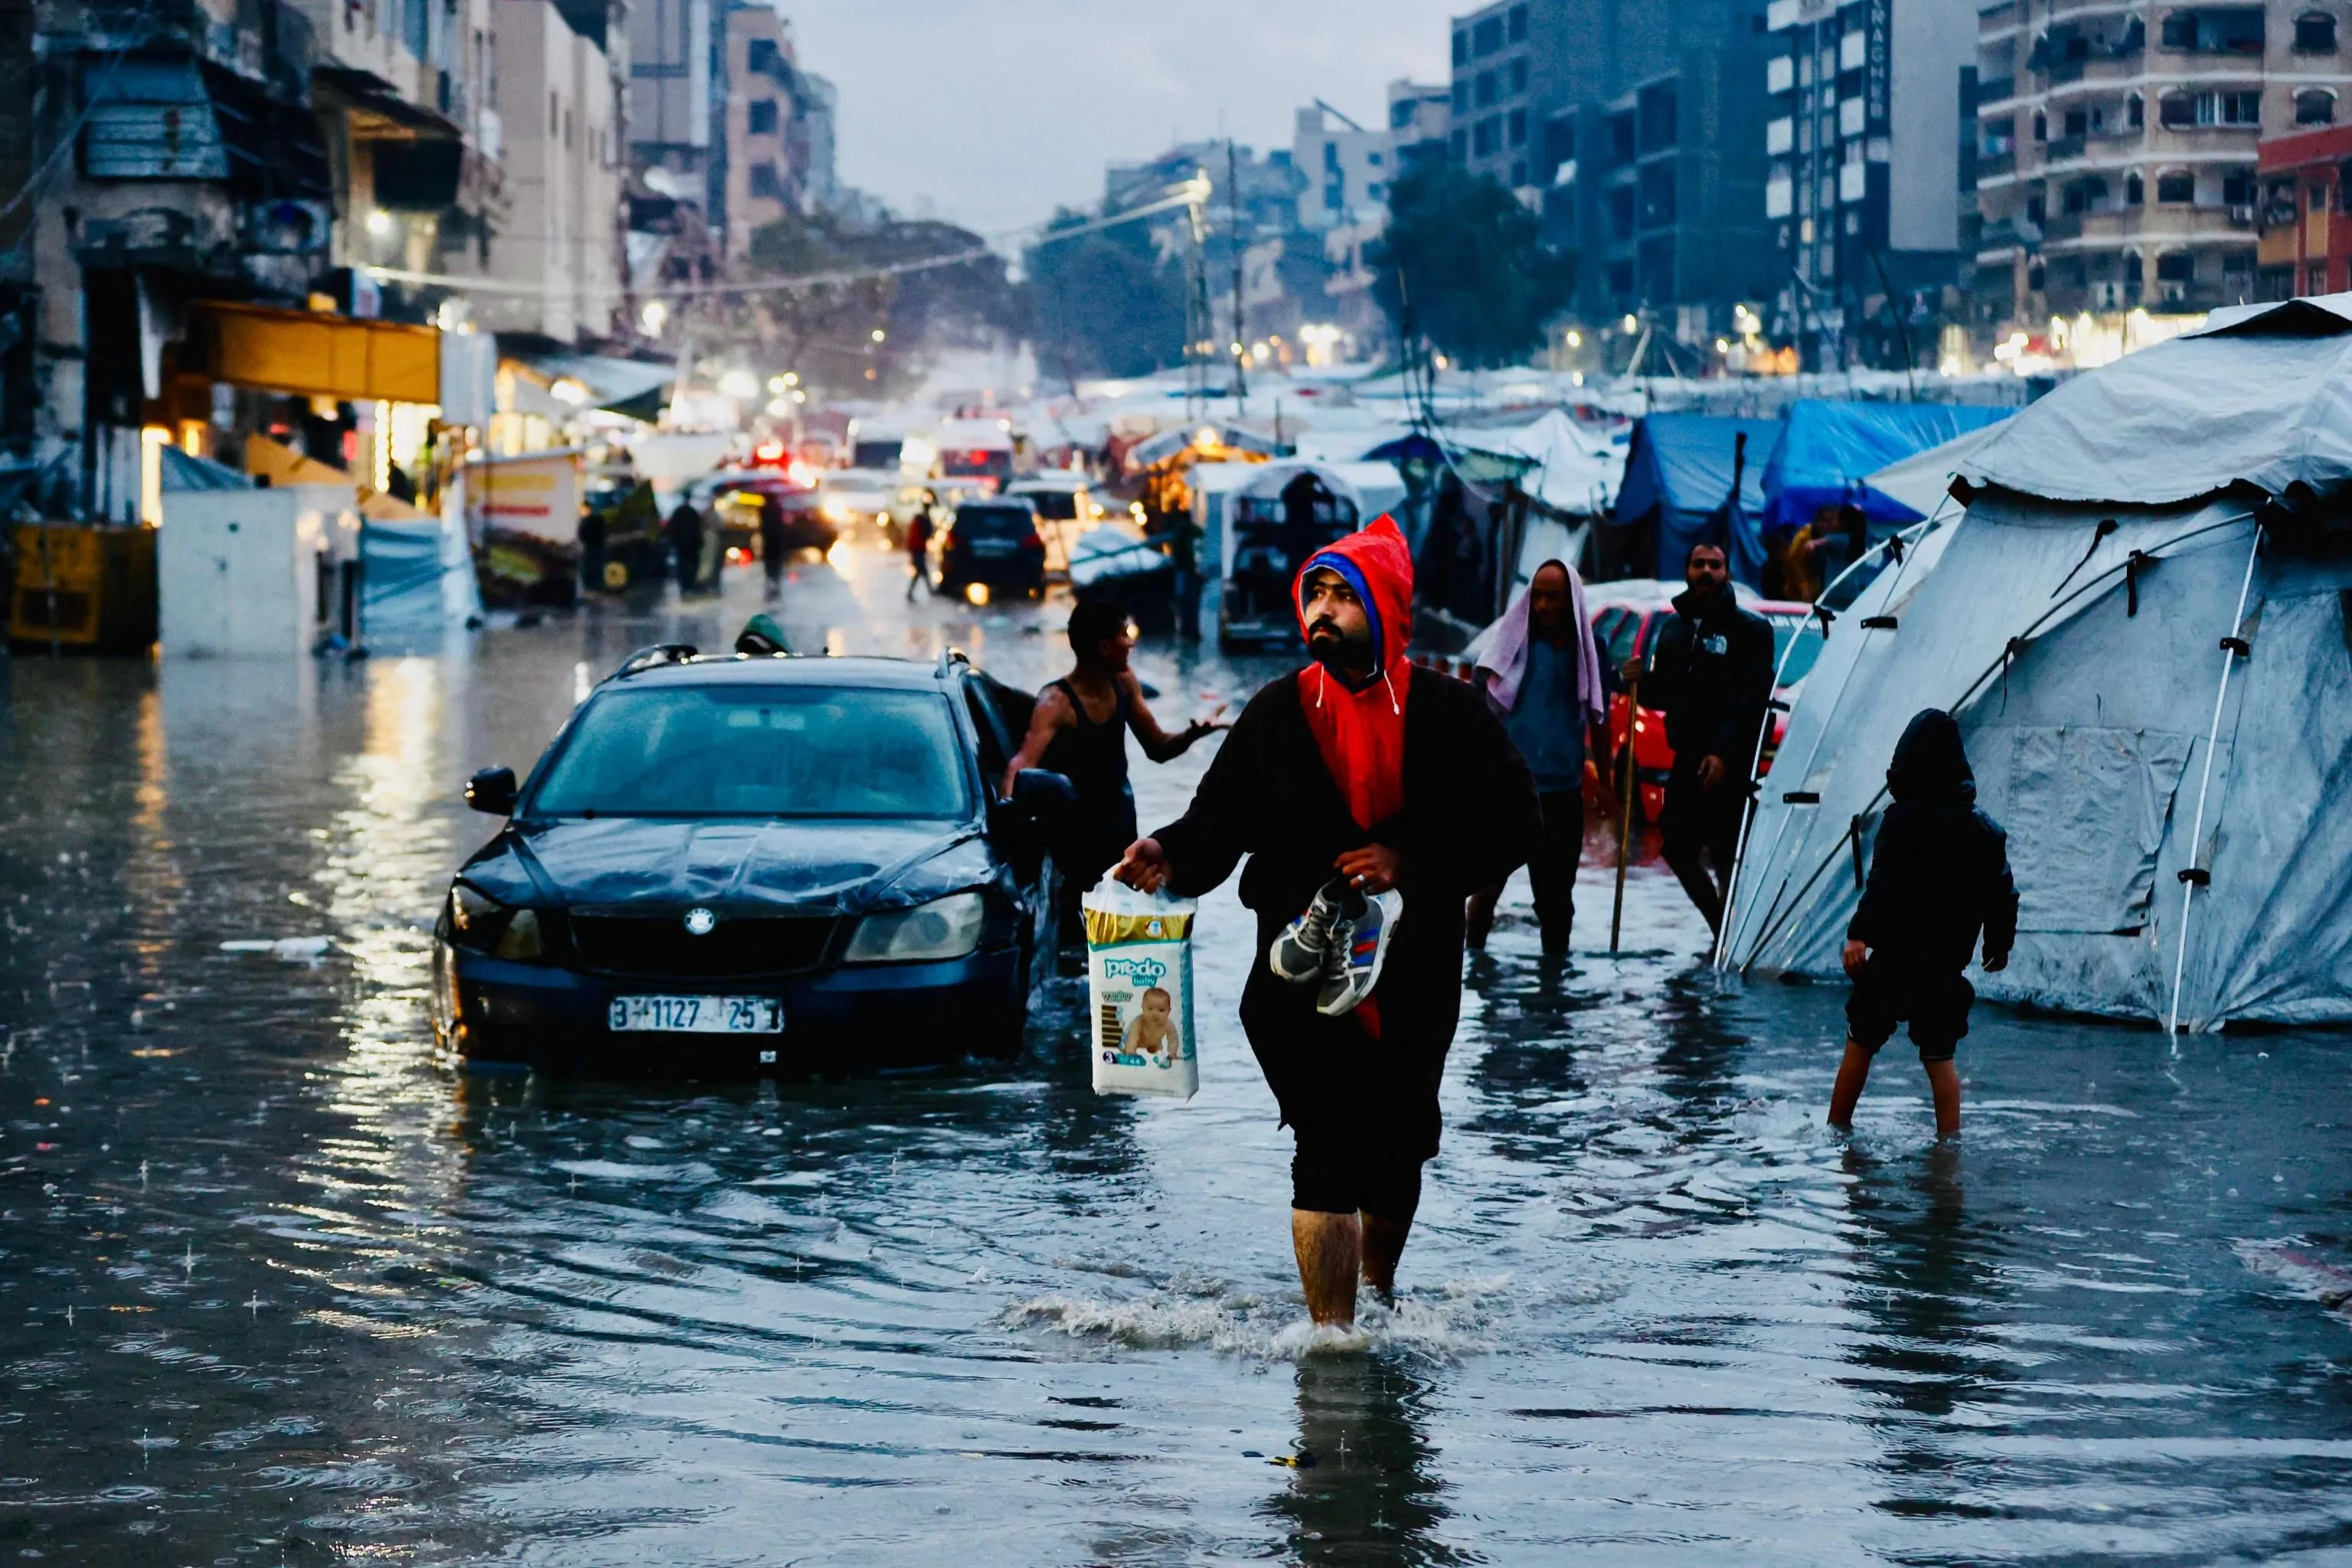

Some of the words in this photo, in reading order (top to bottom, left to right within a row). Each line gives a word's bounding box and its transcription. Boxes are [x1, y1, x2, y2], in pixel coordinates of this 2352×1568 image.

[1106, 958, 1165, 978] predo
[1133, 976, 1155, 985] baby
[652, 1000, 701, 1027] 1127
[729, 1001, 755, 1029] 25
[1105, 1052, 1113, 1063] 3
